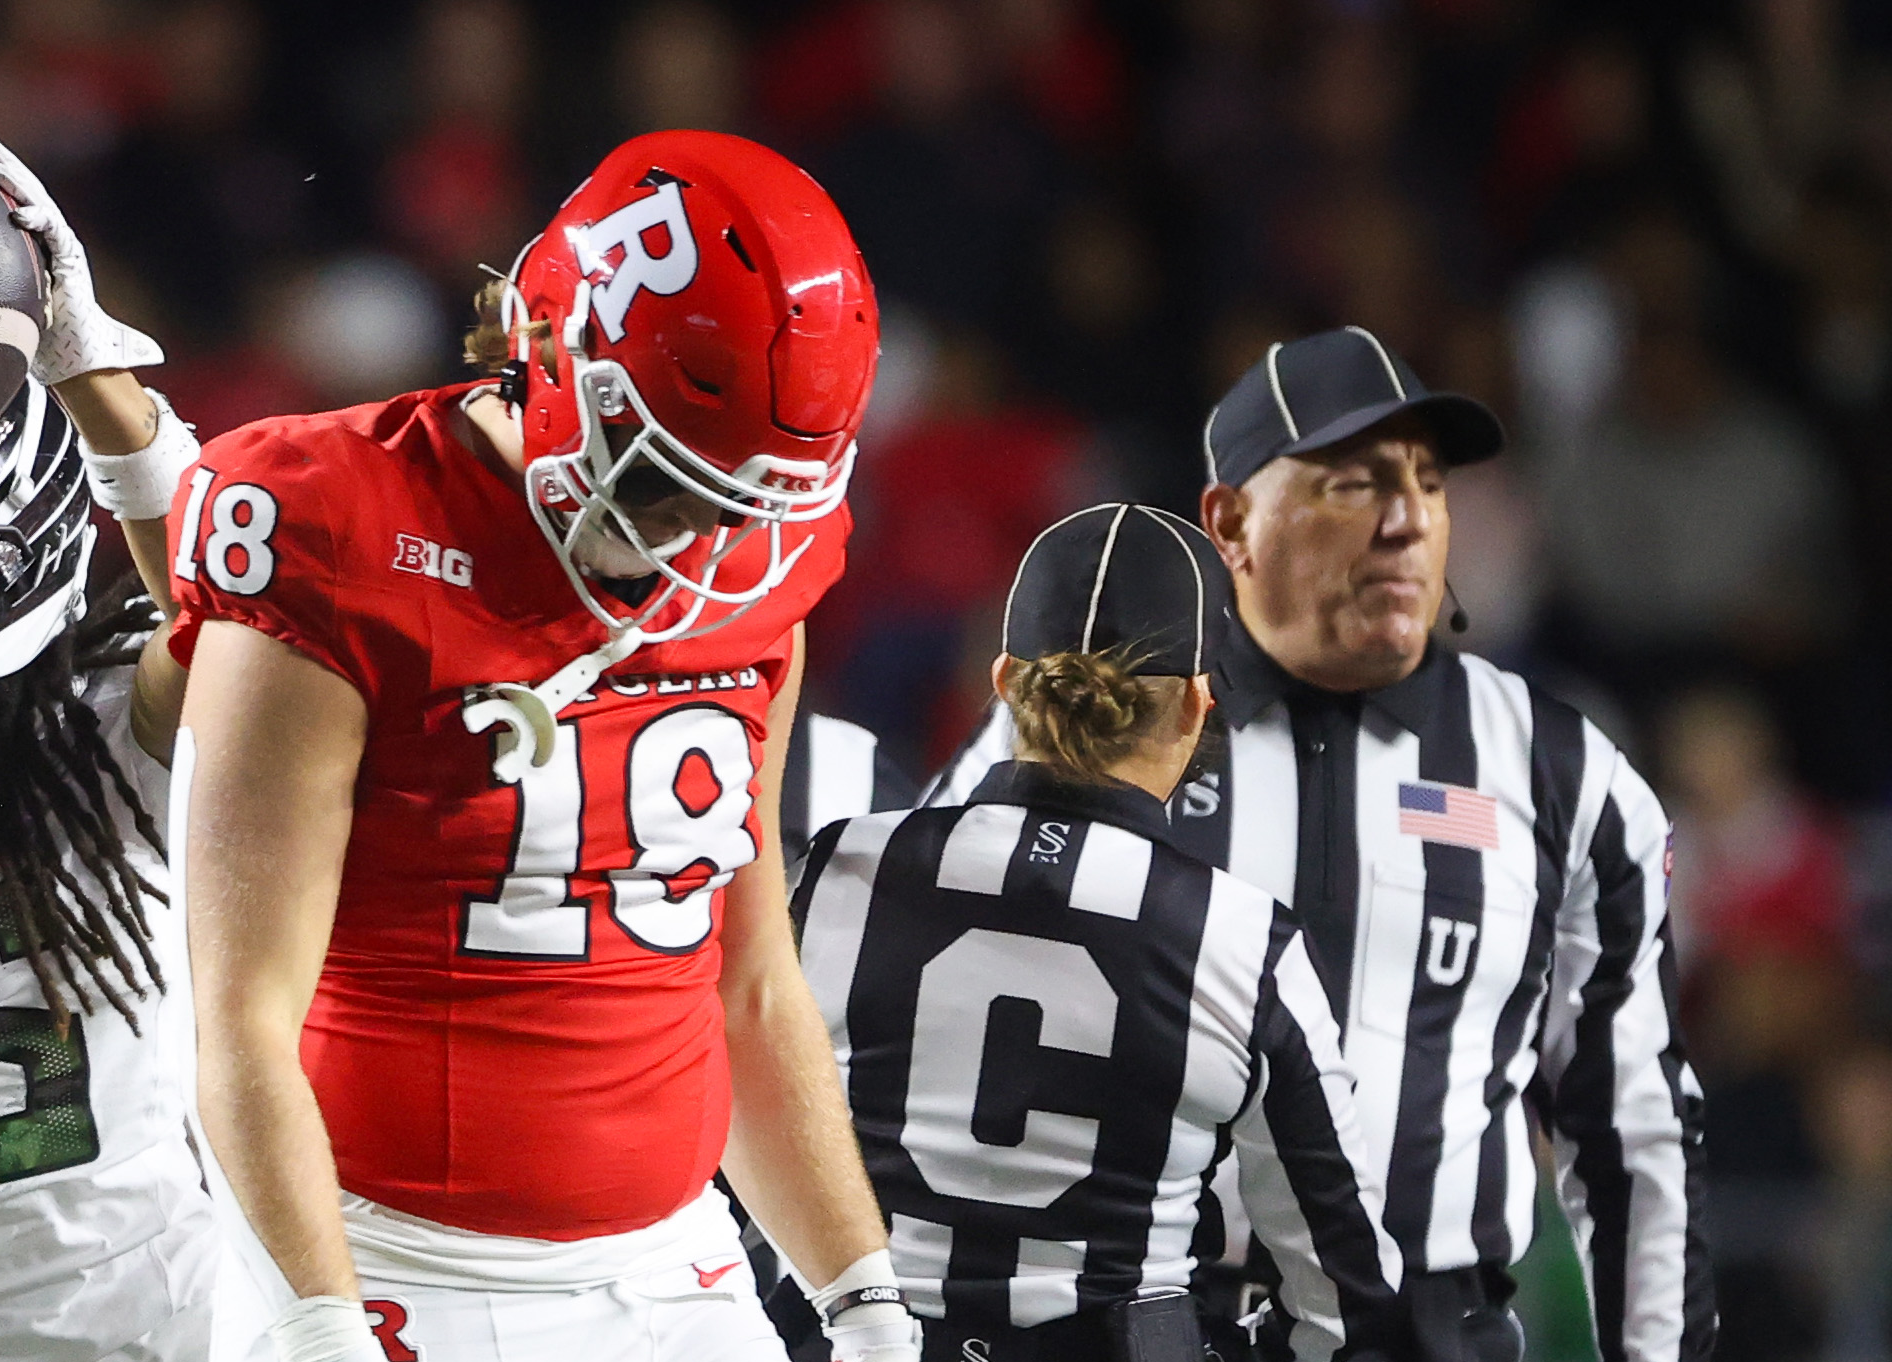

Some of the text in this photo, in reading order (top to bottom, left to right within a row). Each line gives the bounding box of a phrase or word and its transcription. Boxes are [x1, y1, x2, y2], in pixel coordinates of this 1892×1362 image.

[572, 181, 700, 344] R
[174, 465, 280, 596] 18
[457, 701, 764, 962] 18
[1031, 821, 1071, 854] S
[1181, 773, 1221, 818] S
[1426, 915, 1478, 986] U
[900, 928, 1120, 1210] C
[859, 1287, 900, 1301] CHOP
